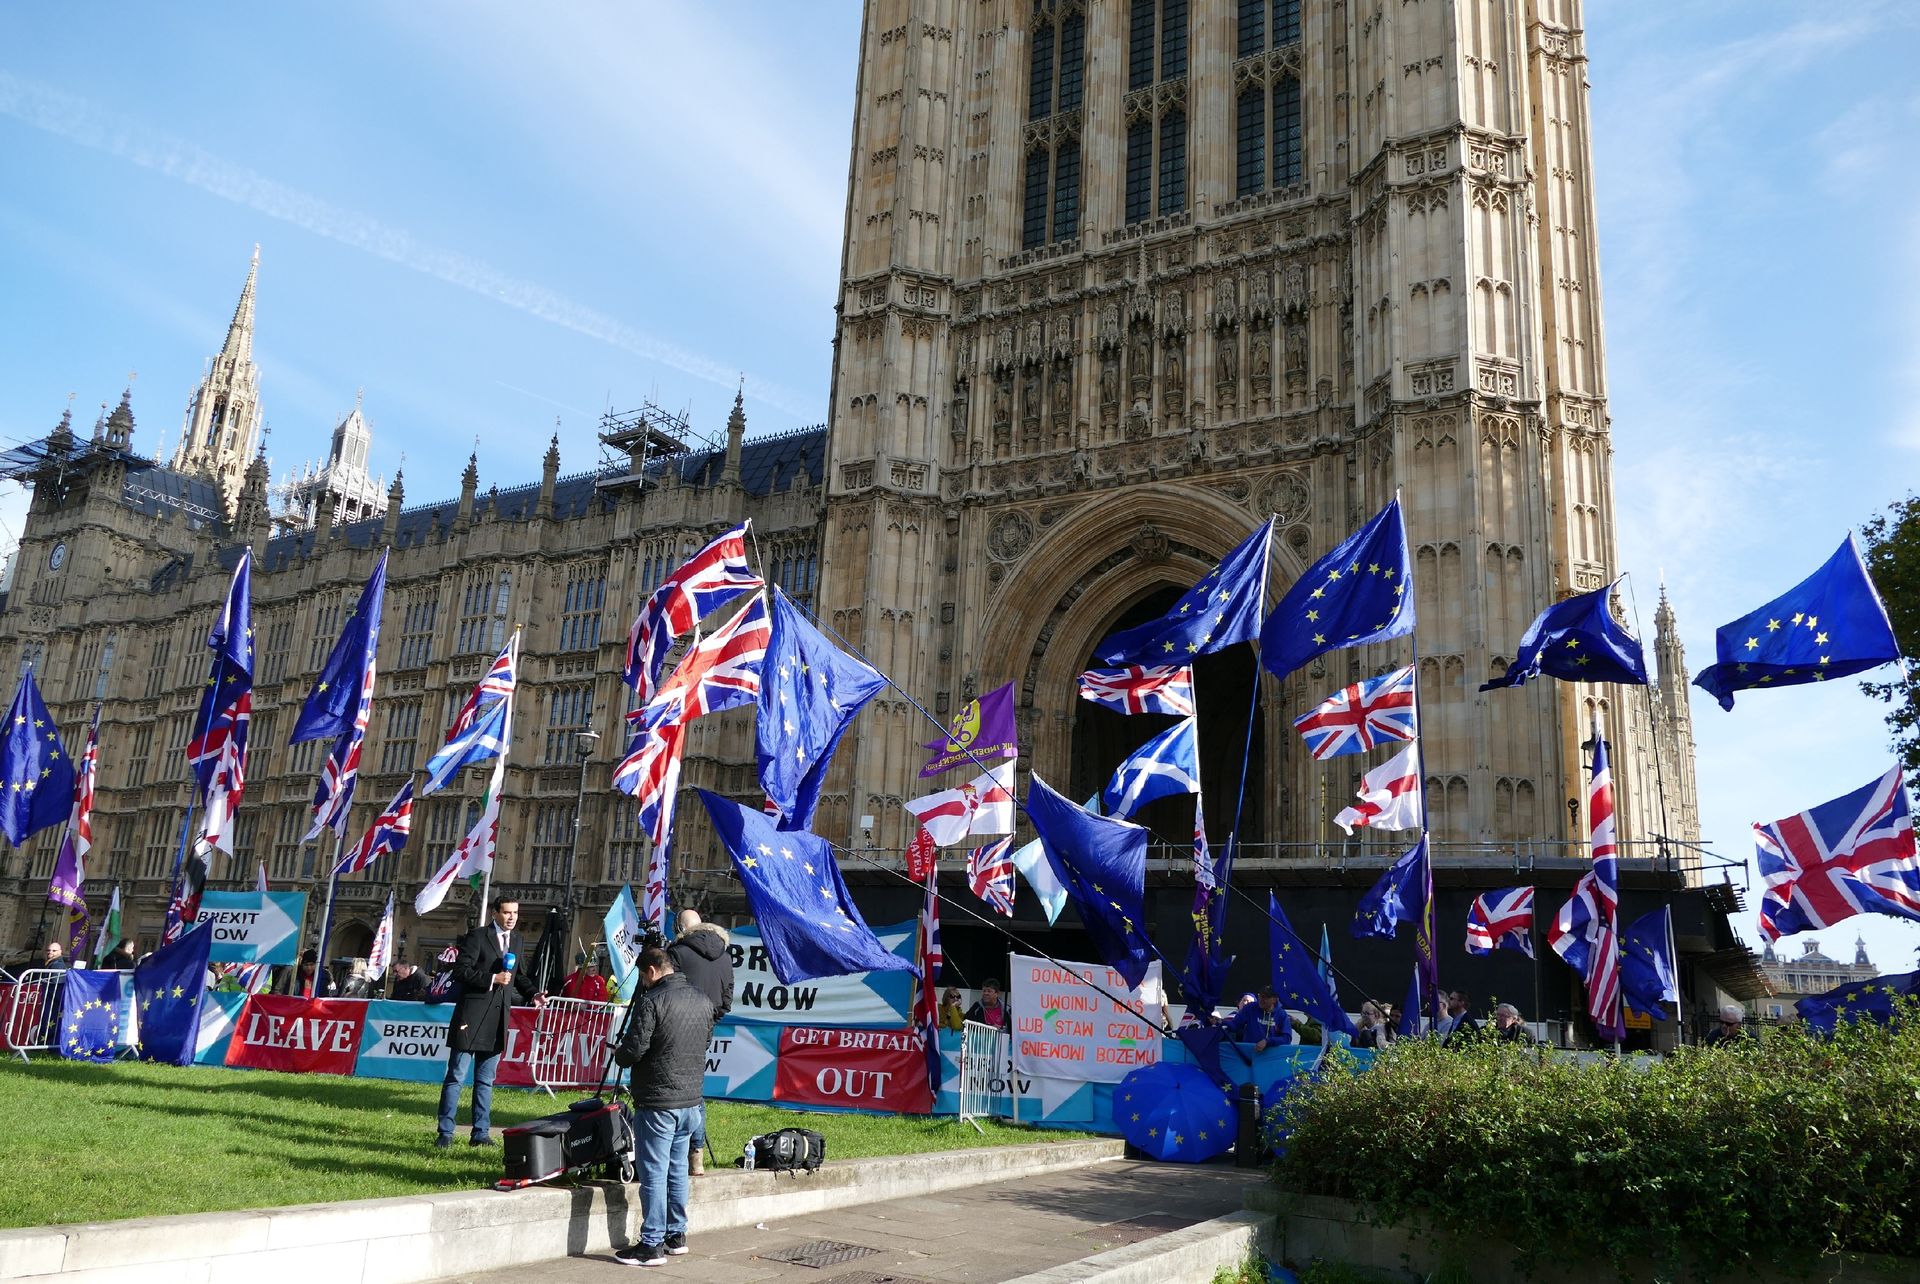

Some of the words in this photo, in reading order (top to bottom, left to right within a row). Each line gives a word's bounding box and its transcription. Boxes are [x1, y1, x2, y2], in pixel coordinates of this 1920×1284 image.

[198, 911, 259, 924] BREXIT
[214, 928, 248, 941] OW
[1031, 968, 1094, 985] DONALD
[742, 982, 818, 1011] NOW
[1113, 1000, 1144, 1014] NAS
[244, 1013, 355, 1053] LEAVE
[383, 1023, 449, 1039] BREXIT
[1018, 1018, 1043, 1034] LUB
[1055, 1020, 1094, 1037] STAW
[791, 1028, 835, 1046] GET
[839, 1031, 924, 1052] BRITAIN
[388, 1042, 439, 1057] NOW
[1021, 1040, 1085, 1061] GNIEWOWI
[816, 1067, 892, 1099] OUT
